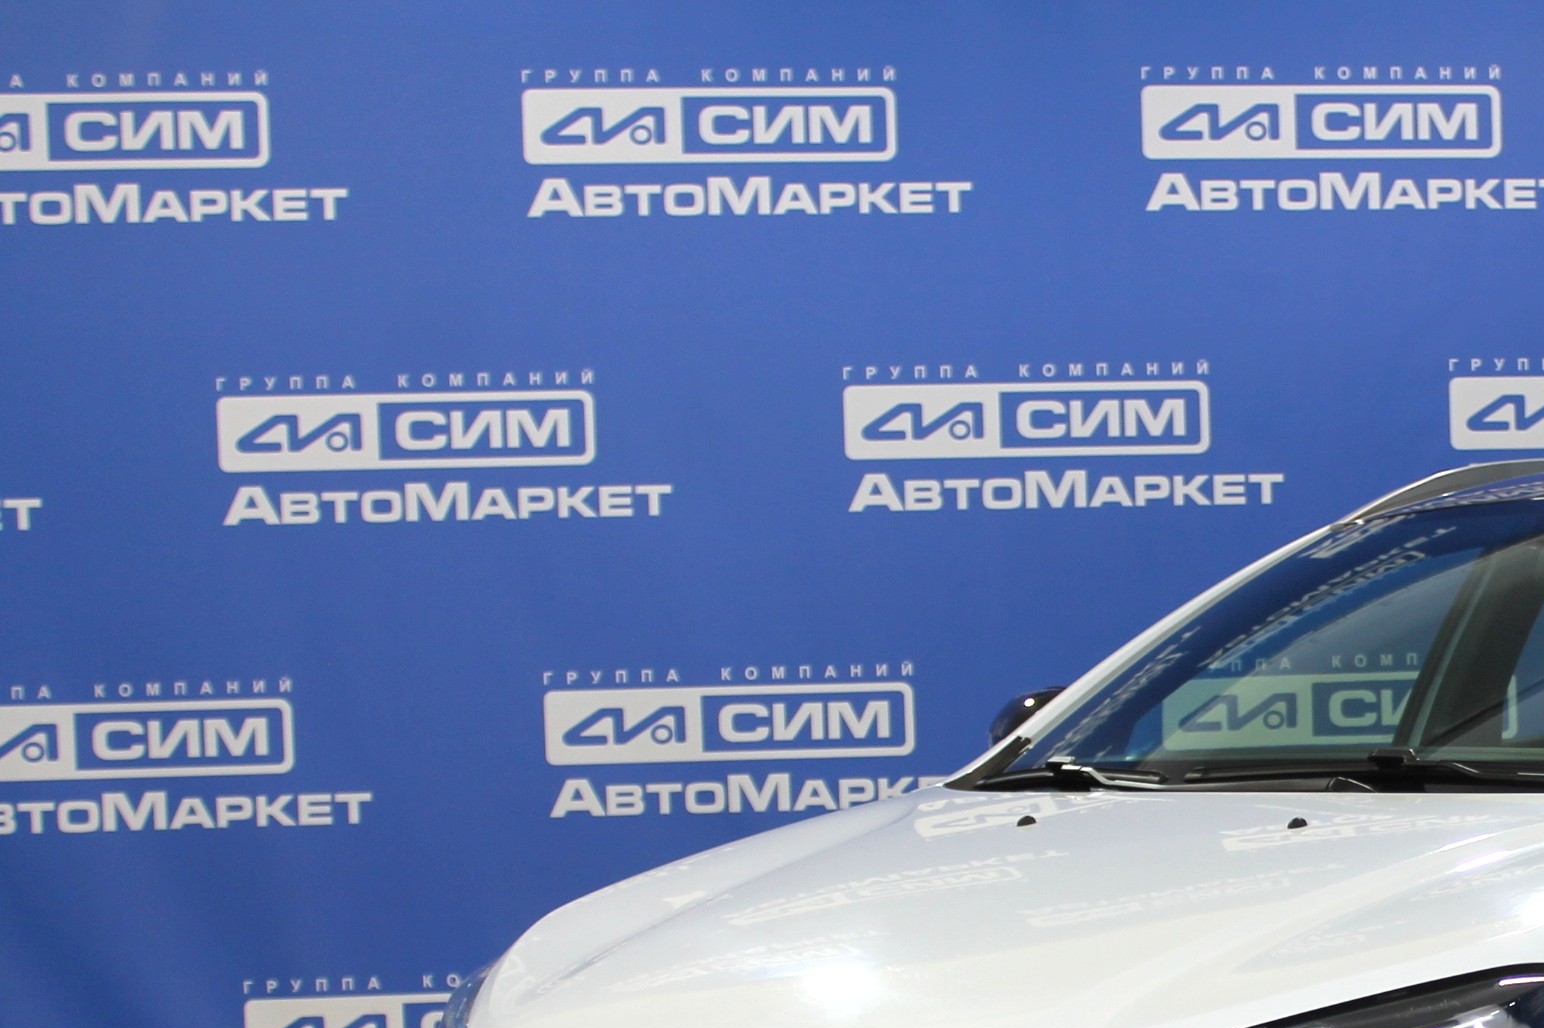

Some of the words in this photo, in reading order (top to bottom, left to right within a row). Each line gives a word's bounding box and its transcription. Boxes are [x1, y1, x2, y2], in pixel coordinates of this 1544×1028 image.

[66, 69, 268, 88] КОМПАНИЙ
[520, 67, 660, 84] ГРУППА
[700, 65, 896, 83] КОМПАНИЙ
[1140, 65, 1275, 80] ГРУППА
[1314, 64, 1502, 80] КОМПАНИЙ
[64, 109, 244, 152] СИМ
[698, 104, 872, 145] СИМ
[1311, 102, 1479, 141] СИМ
[215, 374, 355, 392] ГРУППА
[397, 368, 594, 388] КОМПАНИЙ
[842, 364, 978, 380] ГРУППА
[1018, 359, 1209, 378] КОМПАНИЙ
[394, 407, 571, 451] СИМ
[1015, 398, 1187, 439] СИМ
[93, 676, 293, 698] КОМПАНИЙ
[542, 668, 679, 686] ГРУППА
[720, 660, 913, 681] КОМПАНИЙ
[718, 699, 891, 743] СИМ
[91, 716, 269, 761] СИМ
[550, 773, 947, 818] АвтоМарк
[242, 976, 381, 995] ГРУППА
